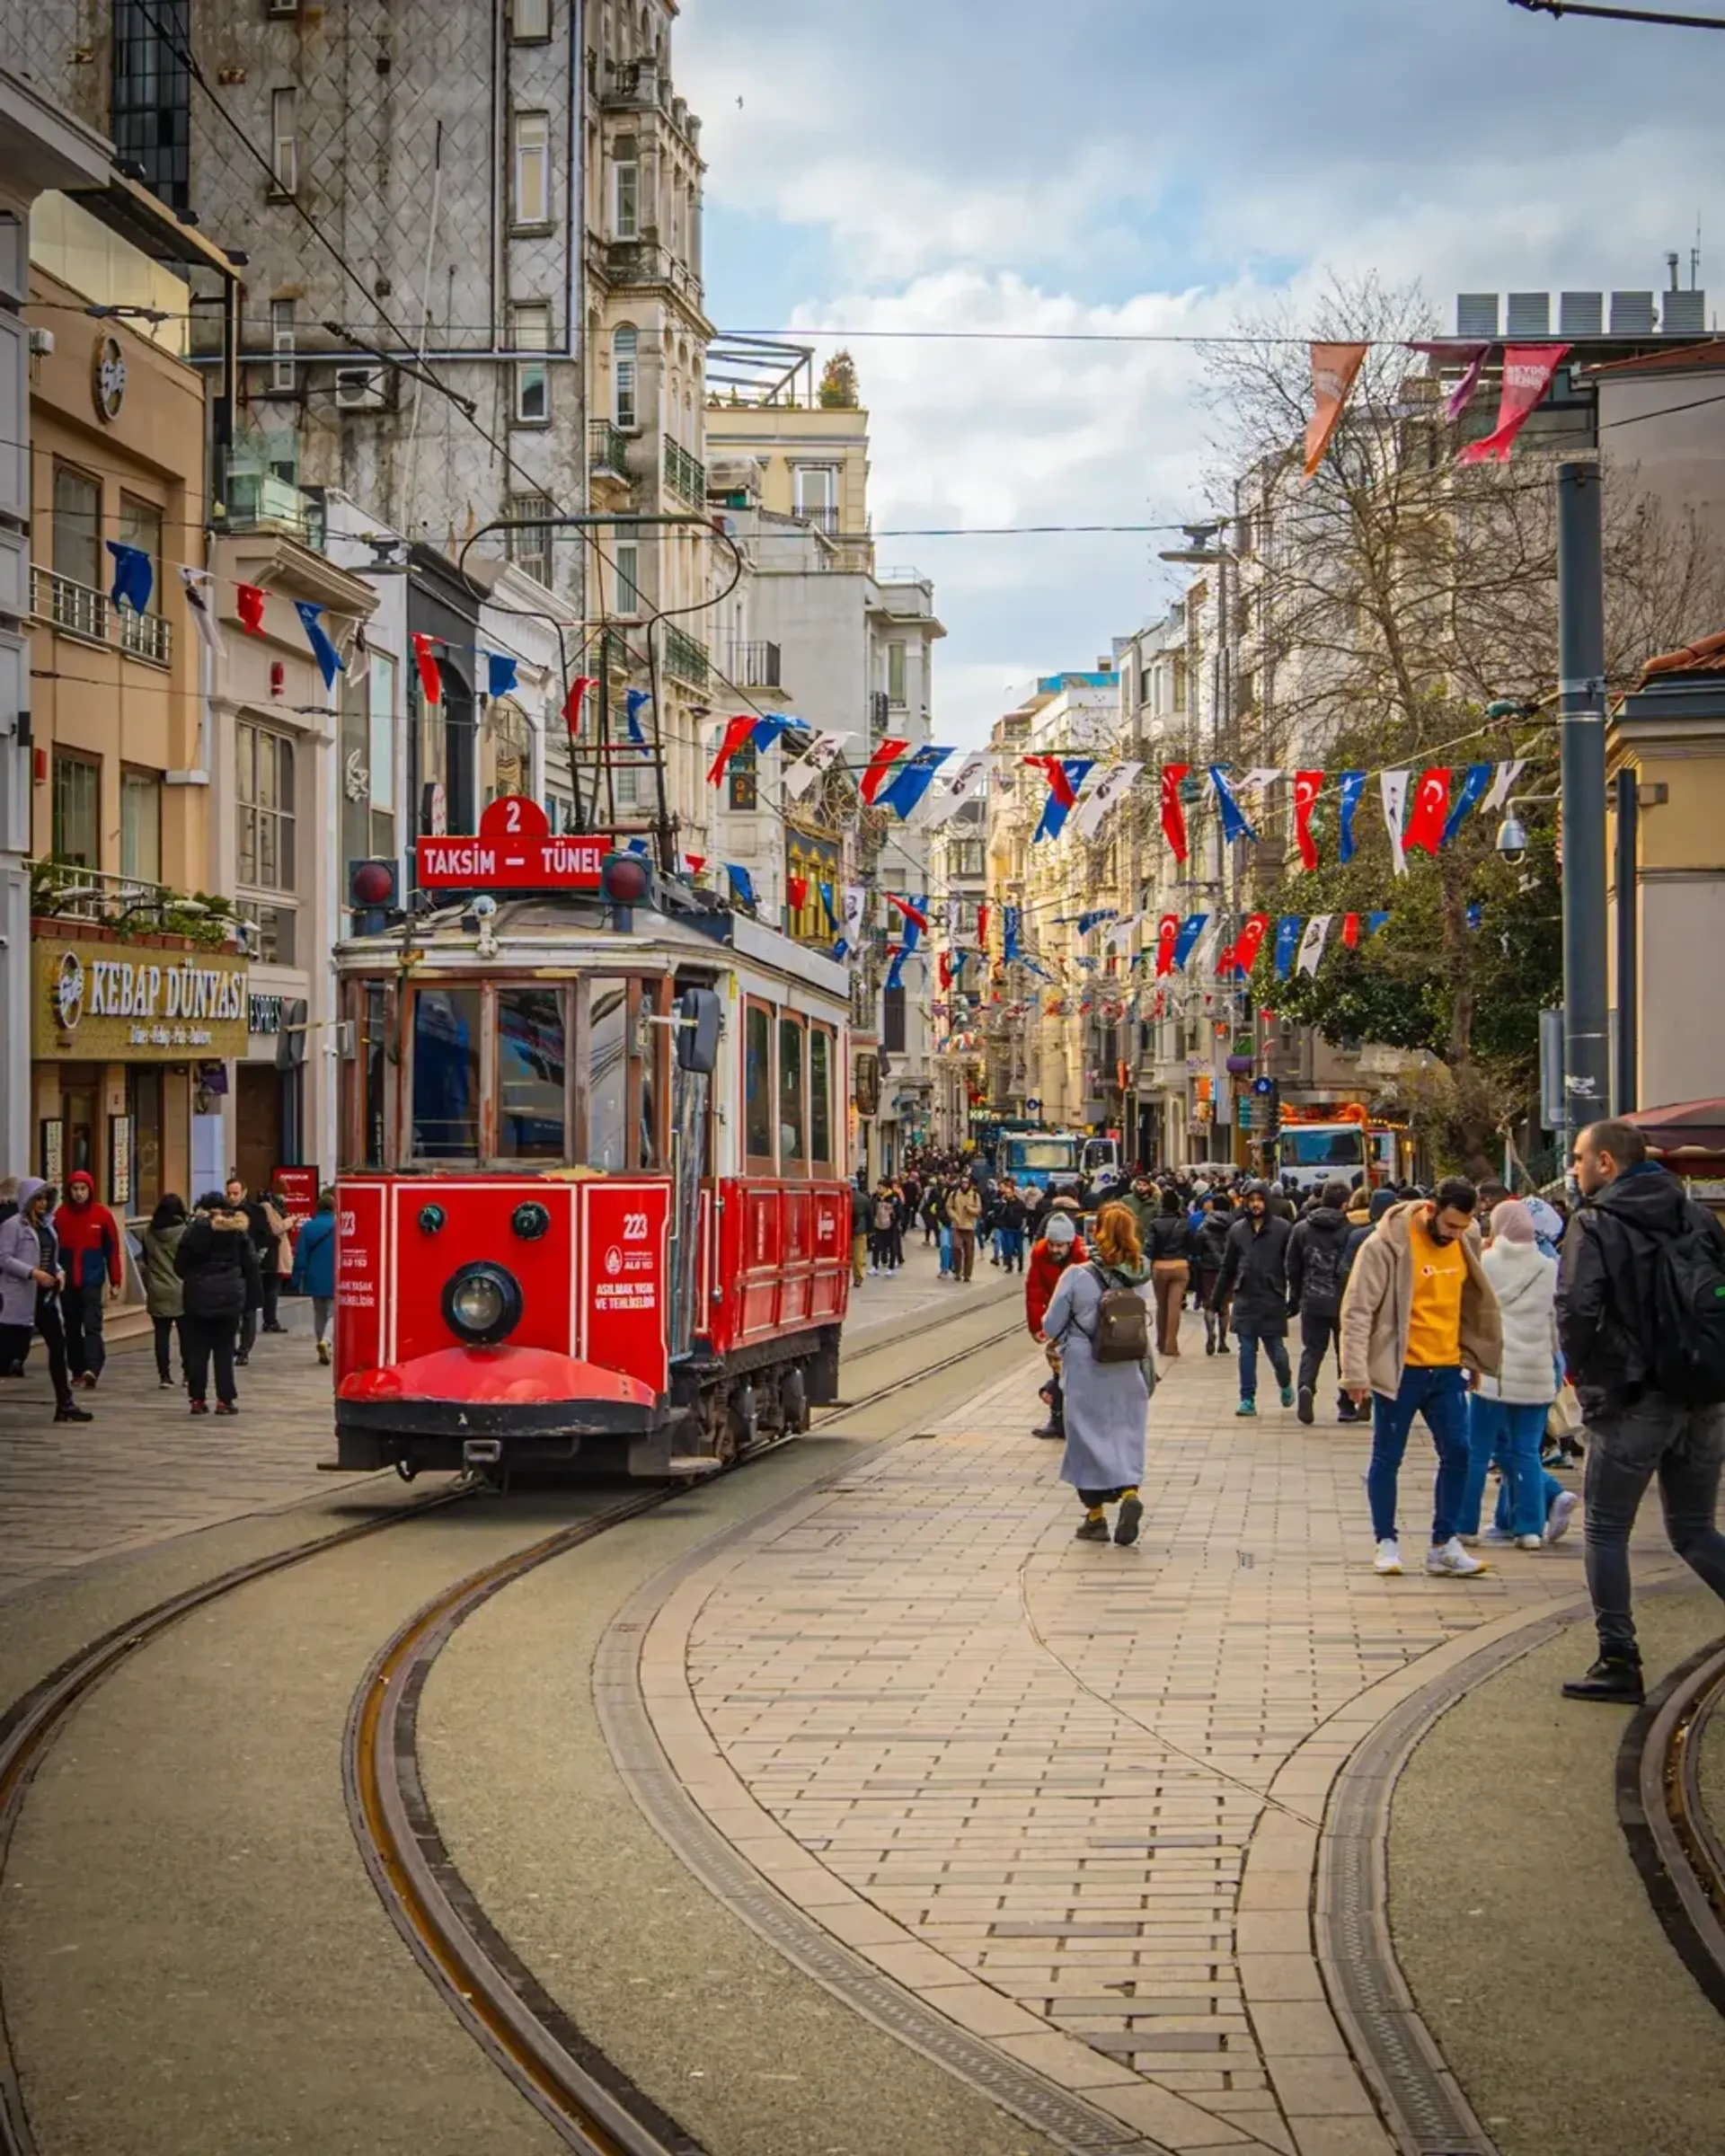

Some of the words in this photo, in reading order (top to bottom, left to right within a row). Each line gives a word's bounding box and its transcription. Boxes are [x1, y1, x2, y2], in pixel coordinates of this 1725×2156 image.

[507, 801, 521, 833] 2
[424, 843, 495, 875] TAKSİM
[541, 841, 603, 873] TÜNEL
[91, 959, 161, 1018] KEBAP
[164, 957, 248, 1021] DÜNYASI
[624, 1213, 648, 1240] 223
